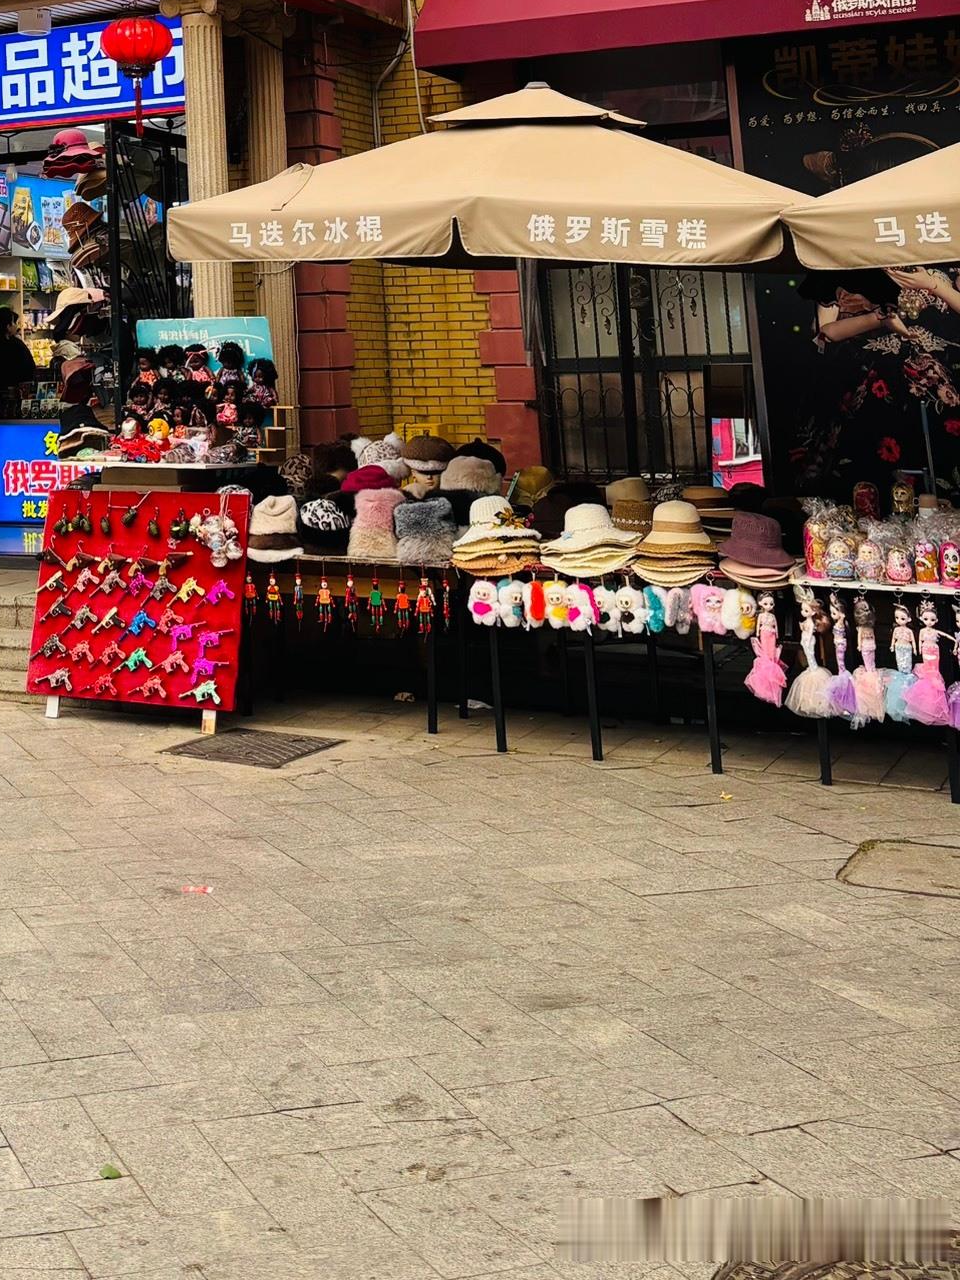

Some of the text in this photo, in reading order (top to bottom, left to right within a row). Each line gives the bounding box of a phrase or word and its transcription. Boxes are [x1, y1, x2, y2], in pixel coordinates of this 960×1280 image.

[228, 214, 384, 248] 马迭尔冰棍
[526, 213, 708, 249] 俄罗斯雪糕
[873, 211, 952, 247] 马迭
[3, 459, 101, 496] 俄罗斯
